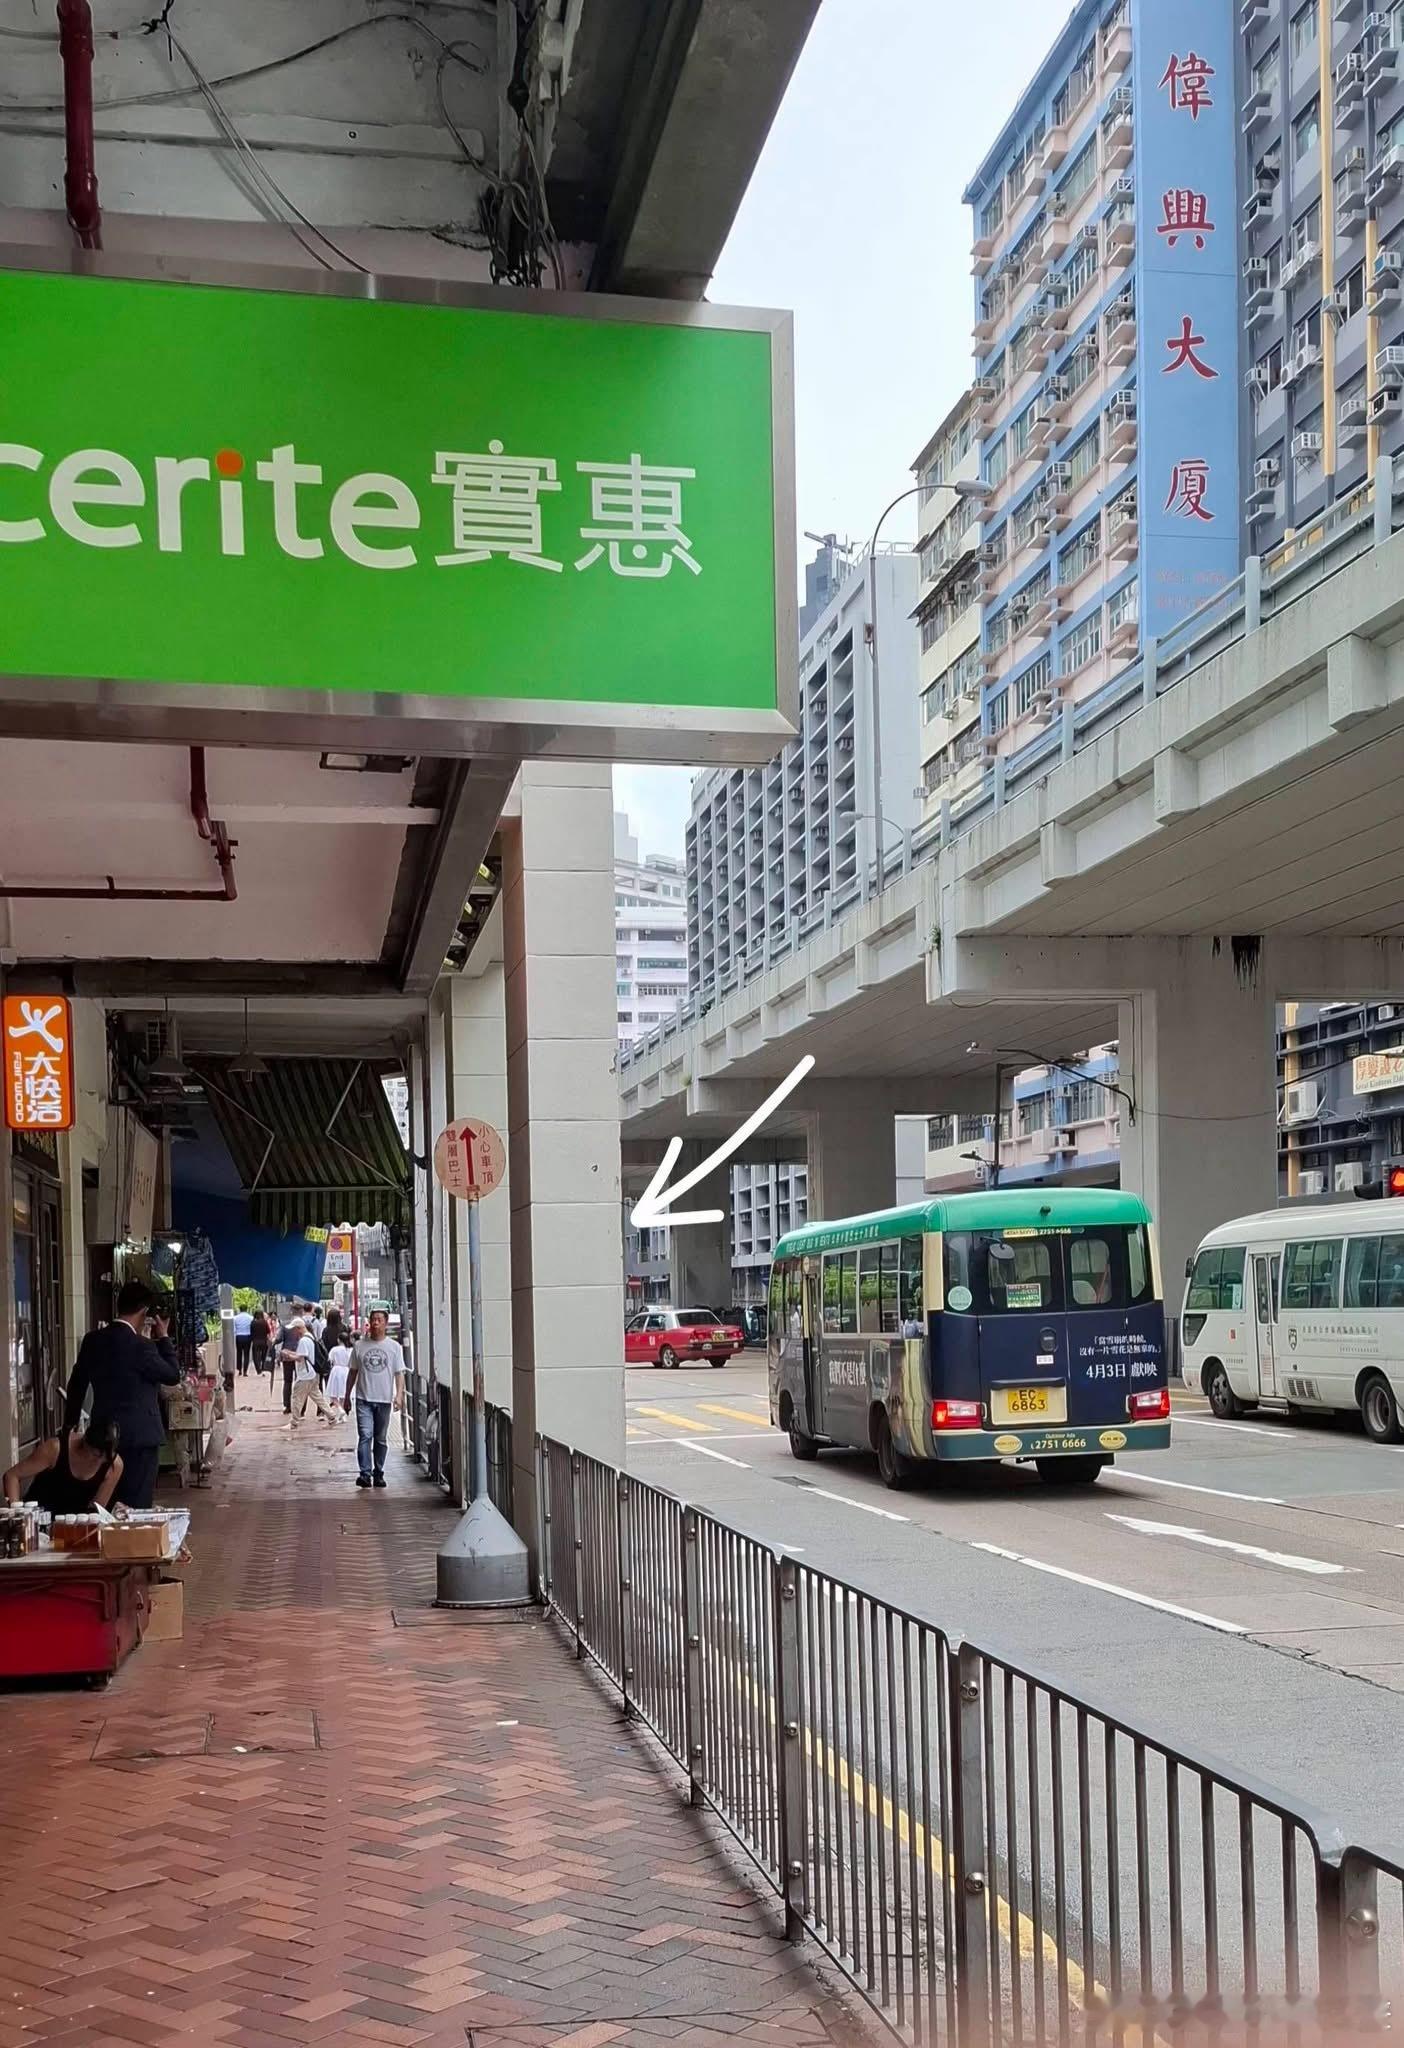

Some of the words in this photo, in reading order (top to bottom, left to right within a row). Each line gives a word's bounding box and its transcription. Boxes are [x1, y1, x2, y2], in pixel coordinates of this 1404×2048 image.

[431, 439, 703, 577] 實惠
[24, 1051, 62, 1122] 大快活
[445, 1130, 461, 1187] 雙層巴士
[479, 1124, 494, 1184] 小心車頂
[1086, 1363, 1126, 1379] 4月3日
[1011, 1400, 1046, 1411] 6863
[1018, 1390, 1037, 1400] EC
[1034, 1440, 1059, 1450] 2751
[1062, 1439, 1087, 1449] 6666
